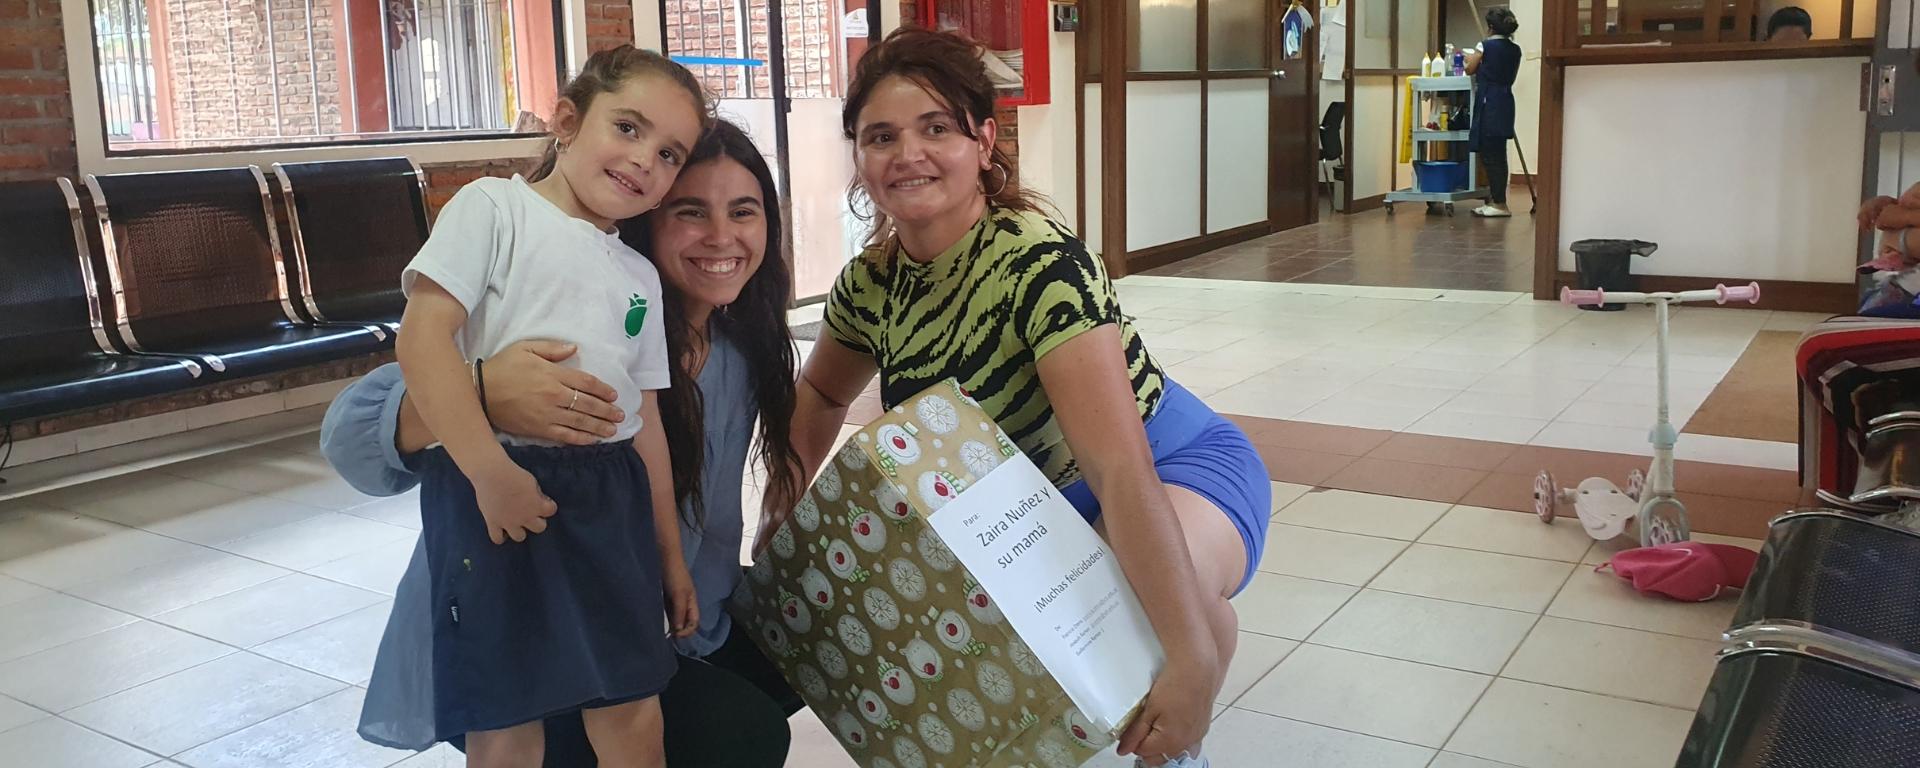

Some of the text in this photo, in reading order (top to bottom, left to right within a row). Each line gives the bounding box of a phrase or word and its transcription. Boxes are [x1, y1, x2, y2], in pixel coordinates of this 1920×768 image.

[963, 513, 981, 527] Para:
[976, 486, 1051, 547] Zaira Nuñez y
[998, 521, 1048, 569] su mamá
[1033, 581, 1068, 613] ¡Muchas
[1064, 546, 1105, 584] felicidades!
